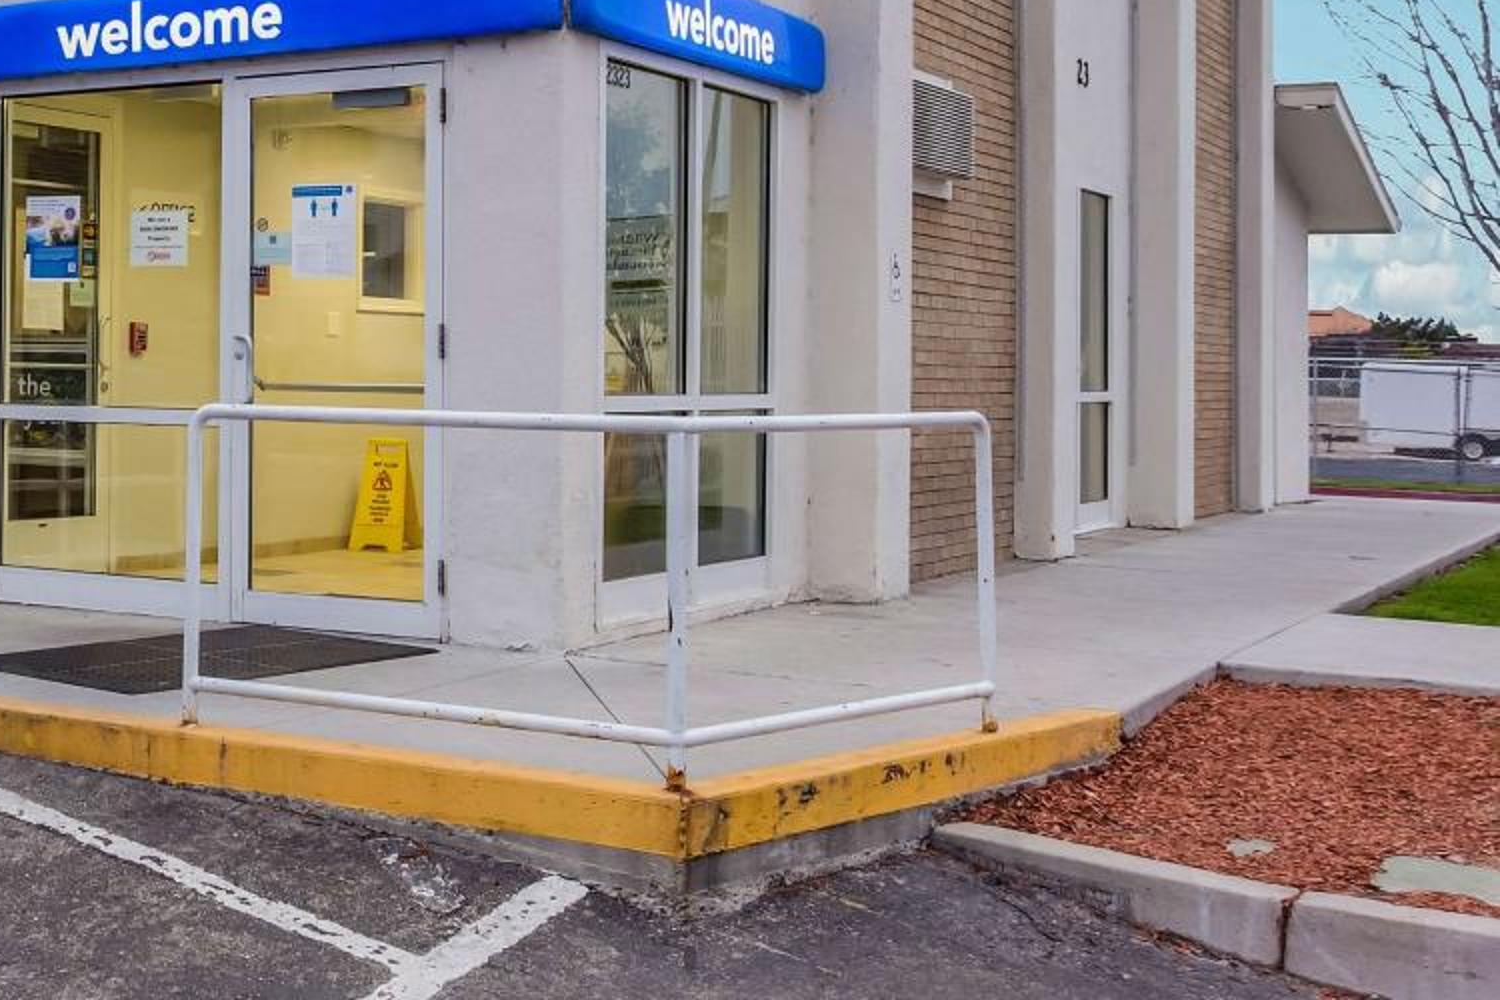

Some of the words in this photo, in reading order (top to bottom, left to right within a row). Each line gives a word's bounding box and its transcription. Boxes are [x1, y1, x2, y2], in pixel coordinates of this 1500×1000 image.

[56, 0, 283, 59] welcome
[1077, 58, 1089, 88] 23
[18, 373, 51, 397] the
